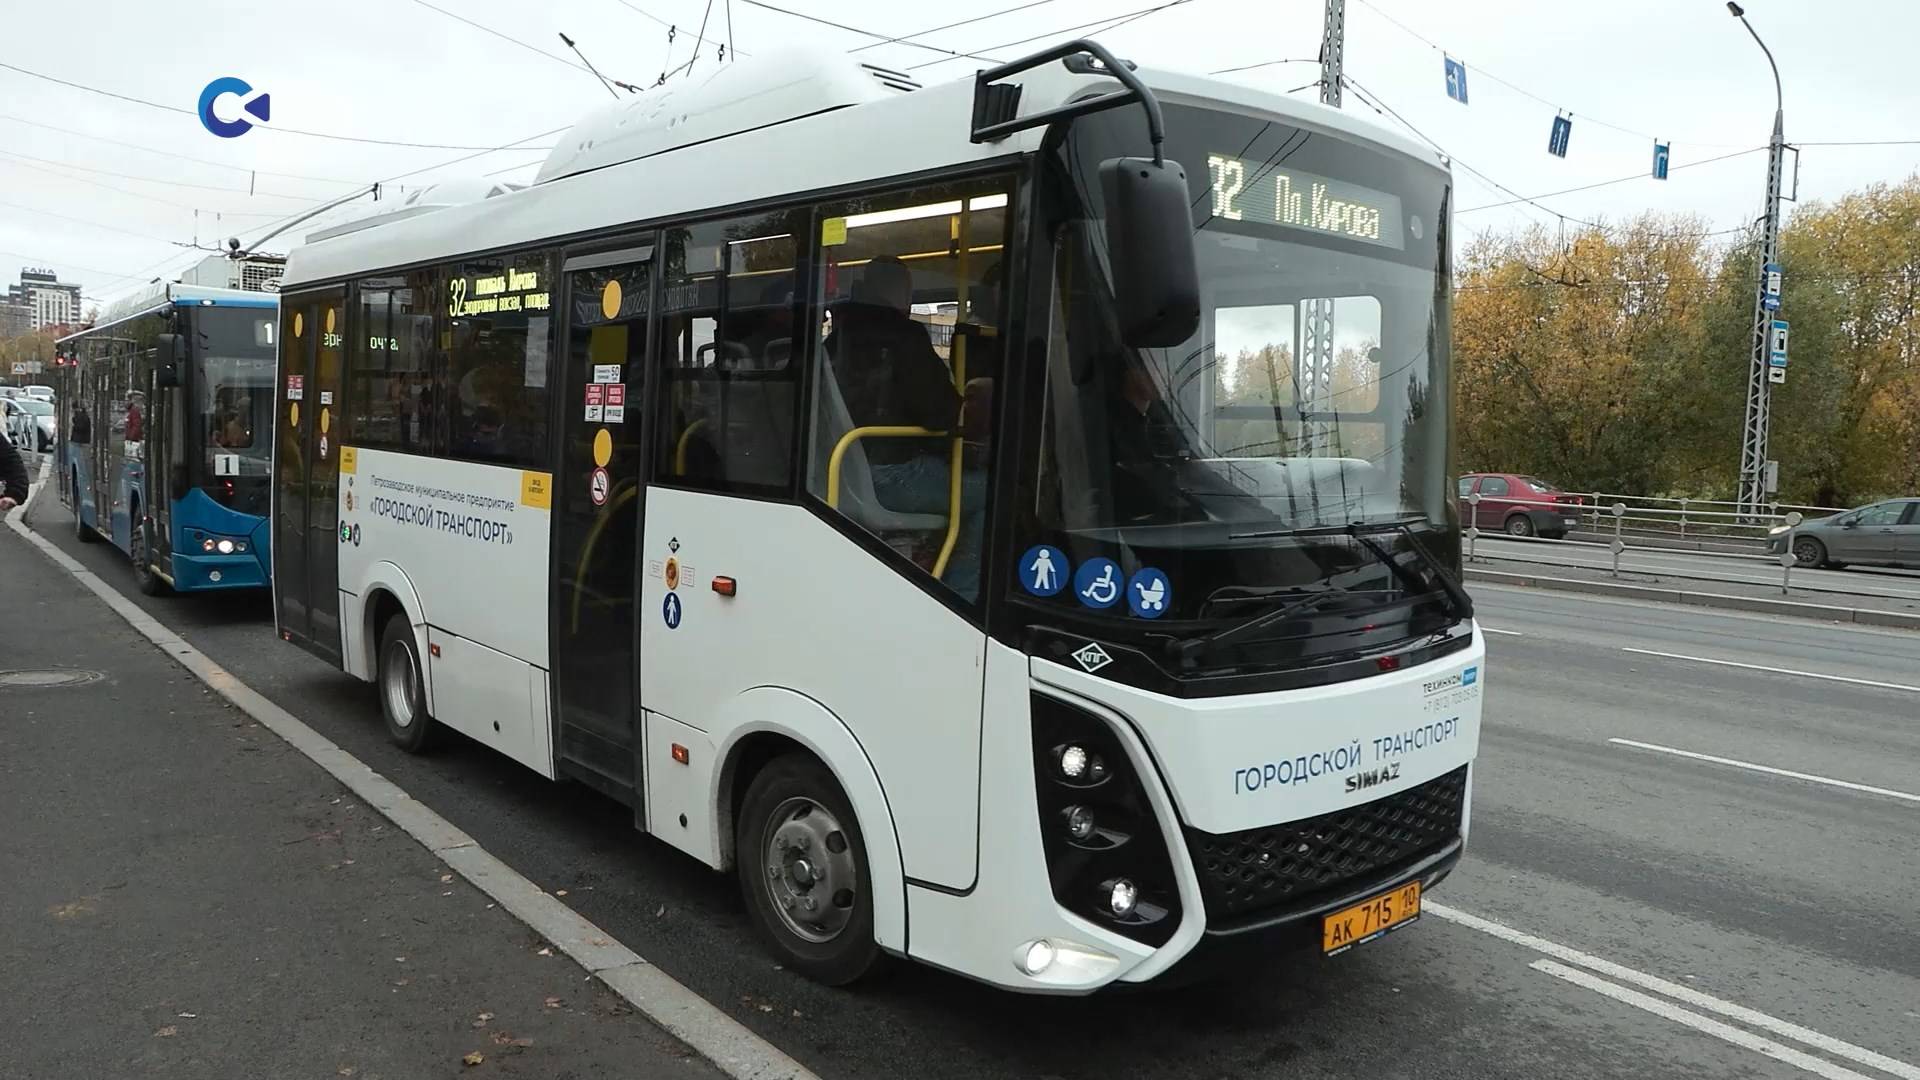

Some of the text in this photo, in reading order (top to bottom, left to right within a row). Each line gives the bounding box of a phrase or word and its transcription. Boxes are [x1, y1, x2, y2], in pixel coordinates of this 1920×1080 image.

[1208, 155, 1243, 220] 32
[22, 266, 56, 275] САНА
[449, 277, 467, 317] 32
[264, 322, 273, 344] 1
[223, 456, 233, 475] 1
[370, 473, 515, 512] Петрозаводское муниципальное предприятие
[370, 496, 513, 545] «ГОРОДСКОЙ ТРАНСПОРТ»
[1081, 651, 1104, 664] КПГ
[1235, 716, 1460, 795] ГОРОДСКОЙ ТРАНСПОРТ
[1344, 762, 1401, 794] SIMAZ
[1361, 896, 1393, 933] 715
[1402, 886, 1416, 909] 10
